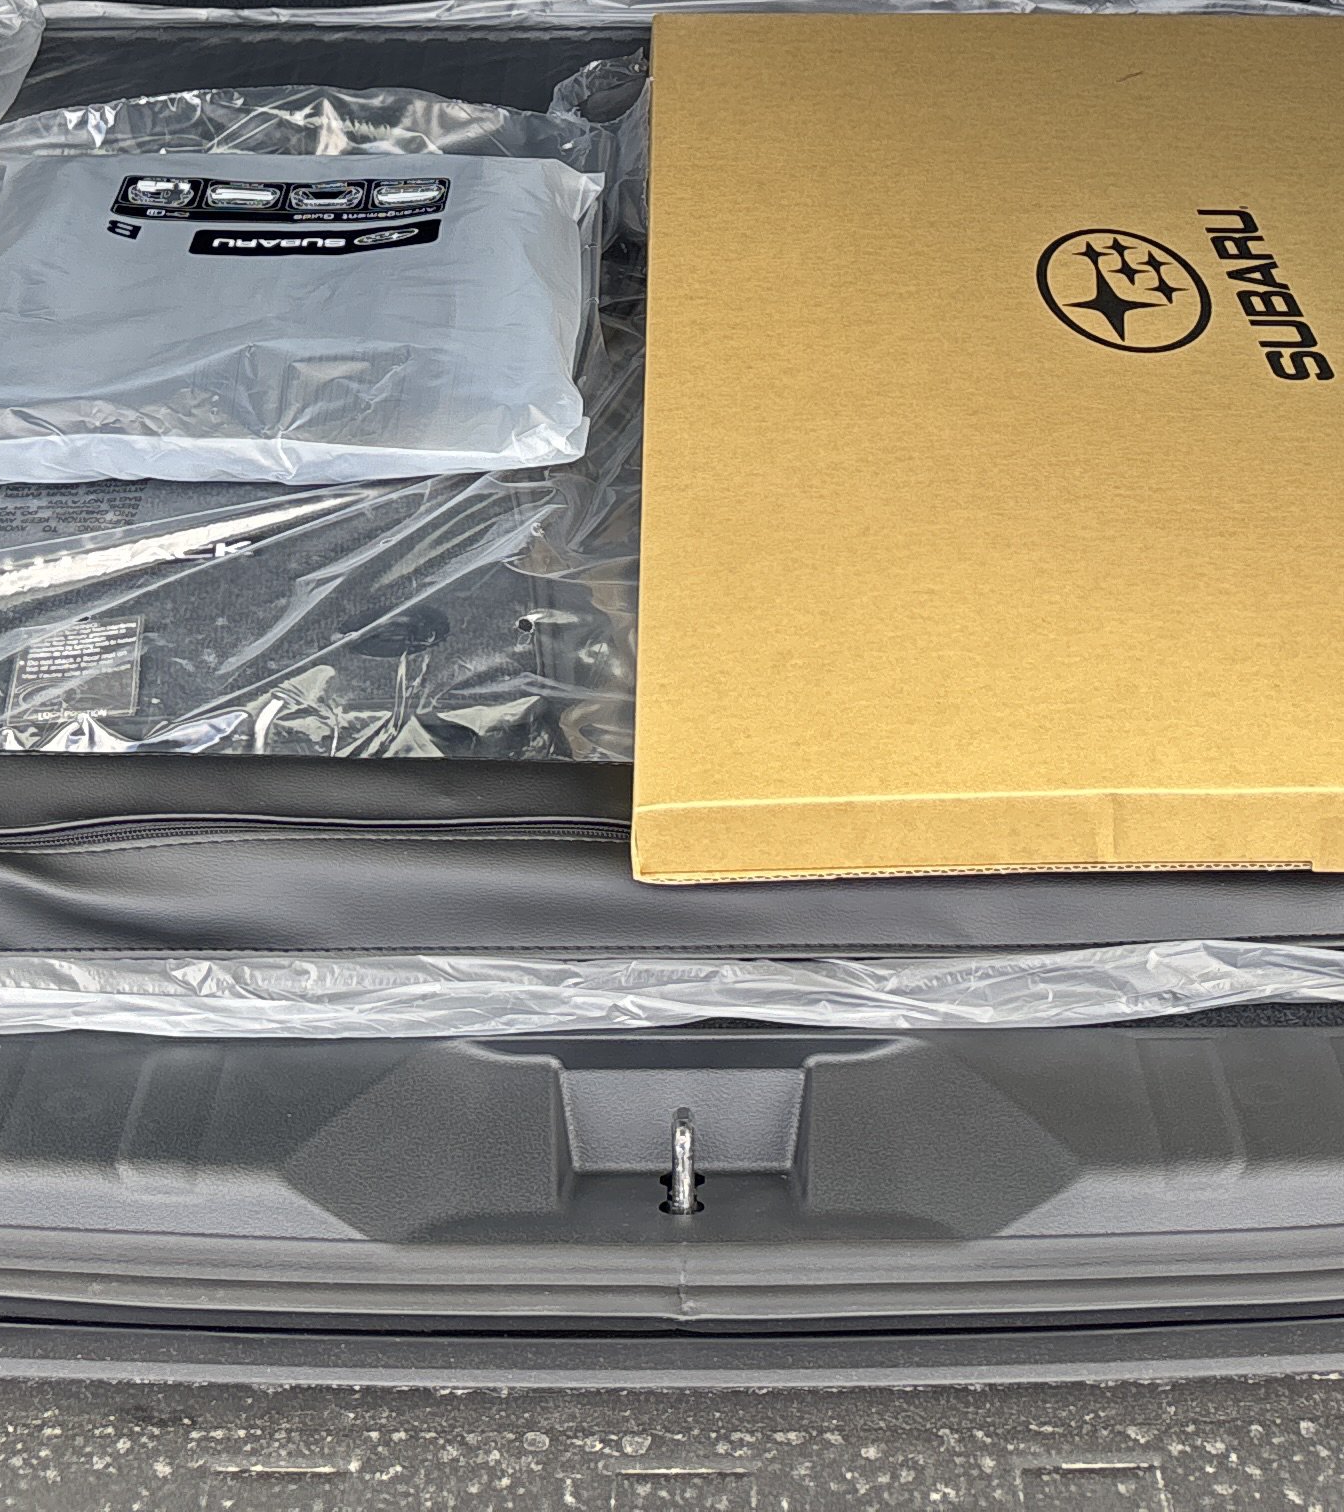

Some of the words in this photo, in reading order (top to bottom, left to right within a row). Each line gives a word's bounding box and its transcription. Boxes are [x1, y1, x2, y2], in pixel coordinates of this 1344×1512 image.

[211, 238, 346, 248] SUBARU
[1197, 209, 1335, 381] SUBARU
[64, 709, 107, 717] POSTION
